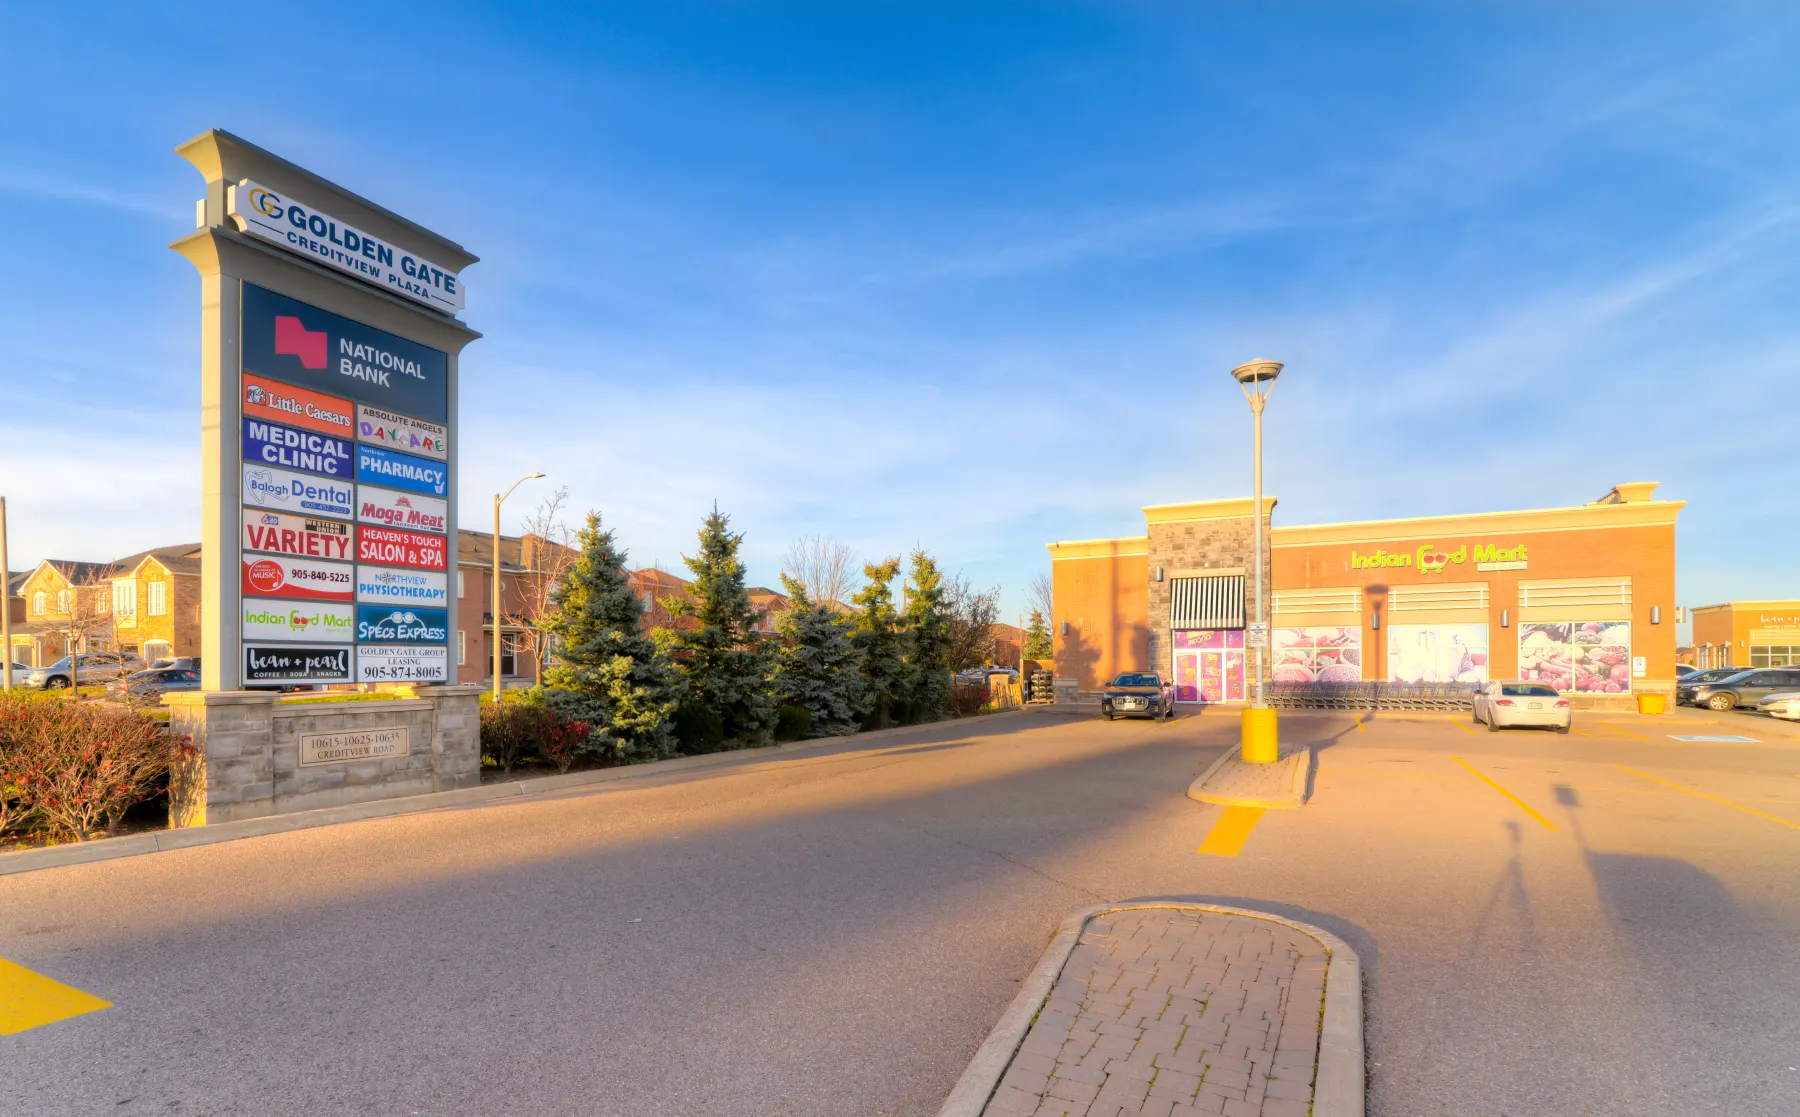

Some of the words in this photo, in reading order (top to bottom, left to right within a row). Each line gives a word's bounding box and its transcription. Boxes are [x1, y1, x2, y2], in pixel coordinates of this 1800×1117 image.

[287, 206, 393, 267] GOLDEN
[401, 256, 456, 295] GATE
[286, 231, 381, 278] CREDITVIEW
[388, 273, 429, 299] PLAZA
[340, 338, 425, 379] NATIONAL
[340, 359, 390, 388] BANK
[268, 392, 302, 415] Little
[305, 403, 351, 427] Caesars
[363, 408, 408, 426] ABSOLUTE
[411, 421, 443, 434] ANGELS
[249, 421, 349, 459] MEDICAL
[360, 421, 445, 452] DAYCARE
[262, 445, 338, 474] CLINIC
[360, 455, 443, 484] PHARMACY
[251, 480, 288, 495] Balogh
[292, 479, 351, 505] Dental
[306, 519, 340, 529] WESTERN
[360, 502, 404, 525] Moga
[407, 509, 444, 528] Meat
[247, 524, 350, 559] VARIETY
[316, 526, 340, 534] UNION
[363, 529, 409, 544] HEAVEN'S
[411, 535, 441, 548] TOUCH
[360, 540, 405, 563] SALON
[408, 550, 417, 564] &
[420, 548, 443, 567] SPA
[1351, 549, 1412, 569] Indian
[1473, 543, 1528, 564] Mart
[252, 571, 276, 579] MUSIC
[291, 569, 350, 583] 905-840-5225
[360, 583, 445, 599] PHYSIOTHERAPY
[245, 608, 286, 625] Indian
[323, 613, 352, 627] Mart
[249, 648, 292, 670] bean
[305, 650, 346, 674] pearl
[360, 647, 395, 656] GOLDEN
[397, 648, 418, 656] GATE
[419, 648, 445, 657] GROUP
[364, 666, 442, 679] 905-874-8005
[311, 732, 400, 749] 10615-10625-10635
[317, 746, 370, 760] CREDITVIEW
[373, 744, 395, 754] ROAD
